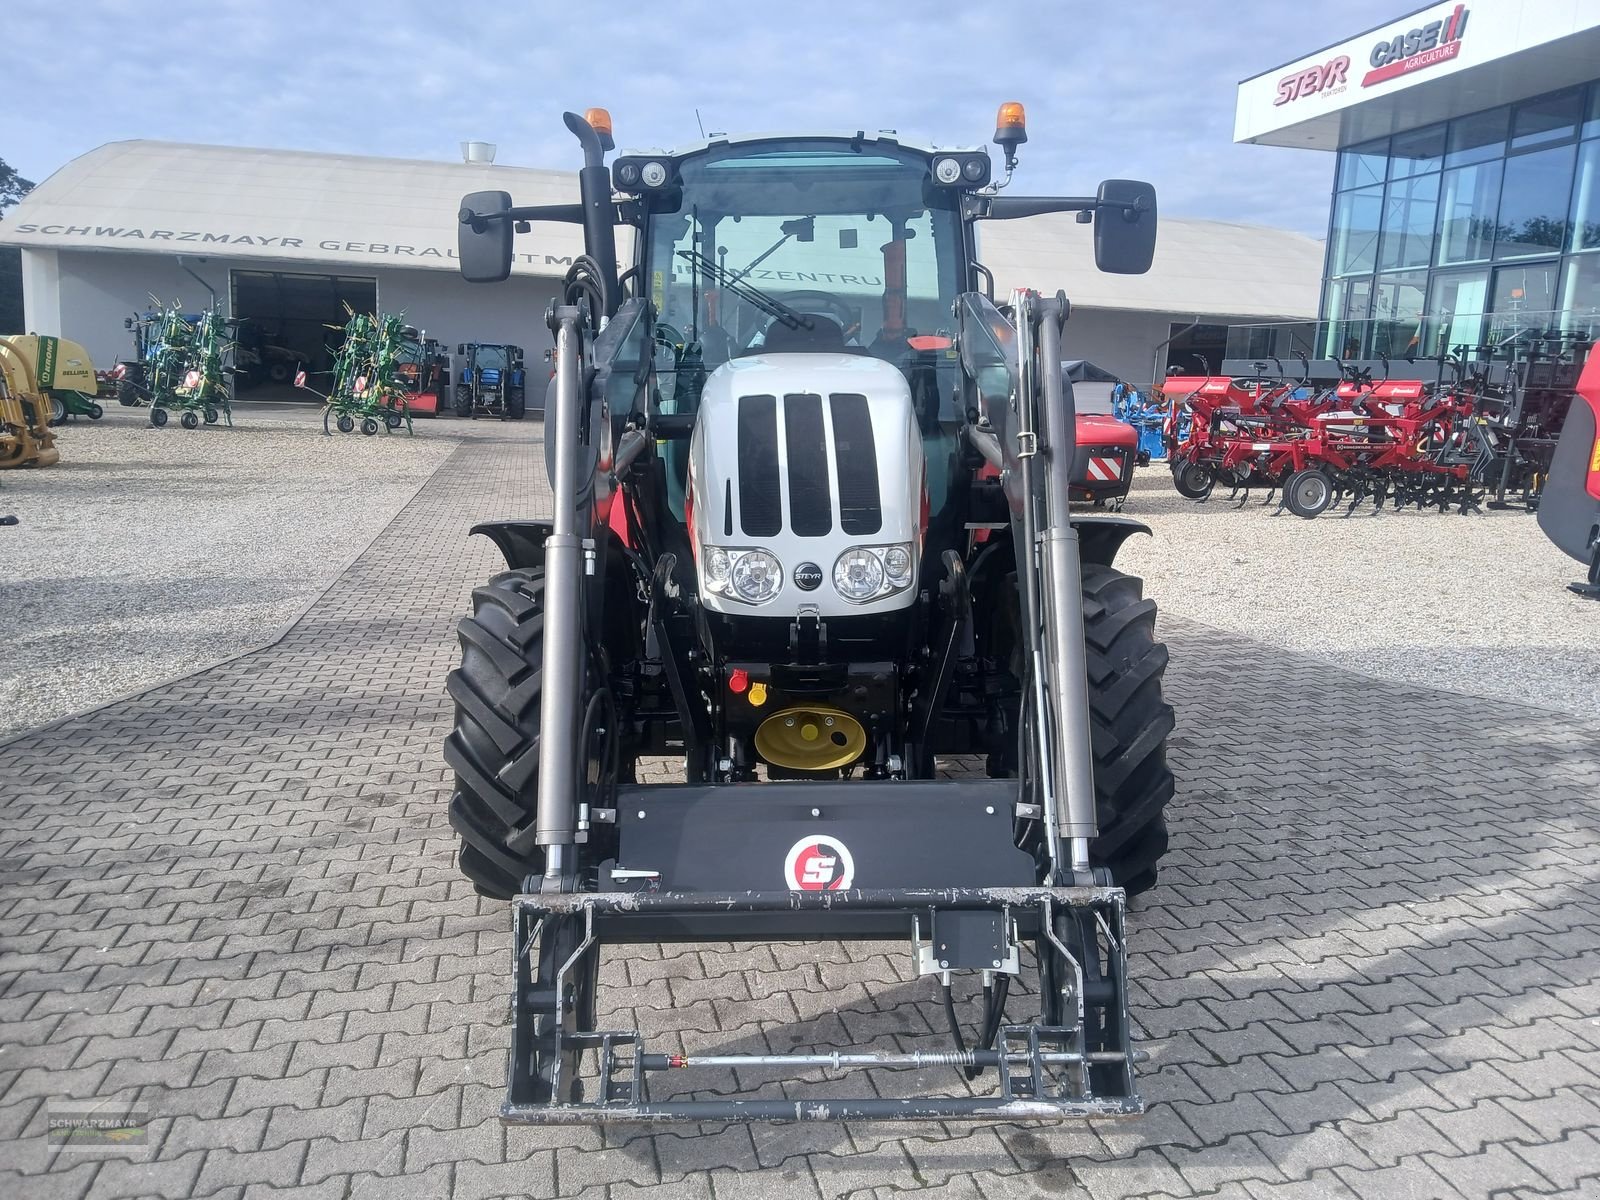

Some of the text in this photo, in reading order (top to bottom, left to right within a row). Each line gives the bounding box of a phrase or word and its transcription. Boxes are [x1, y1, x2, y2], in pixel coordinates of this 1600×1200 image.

[1369, 20, 1443, 68] CASE
[1404, 45, 1455, 71] AGRICULTURE
[1273, 55, 1350, 107] STEYR
[15, 224, 304, 248] SCHWARZMAYR
[45, 338, 54, 373] KRONE
